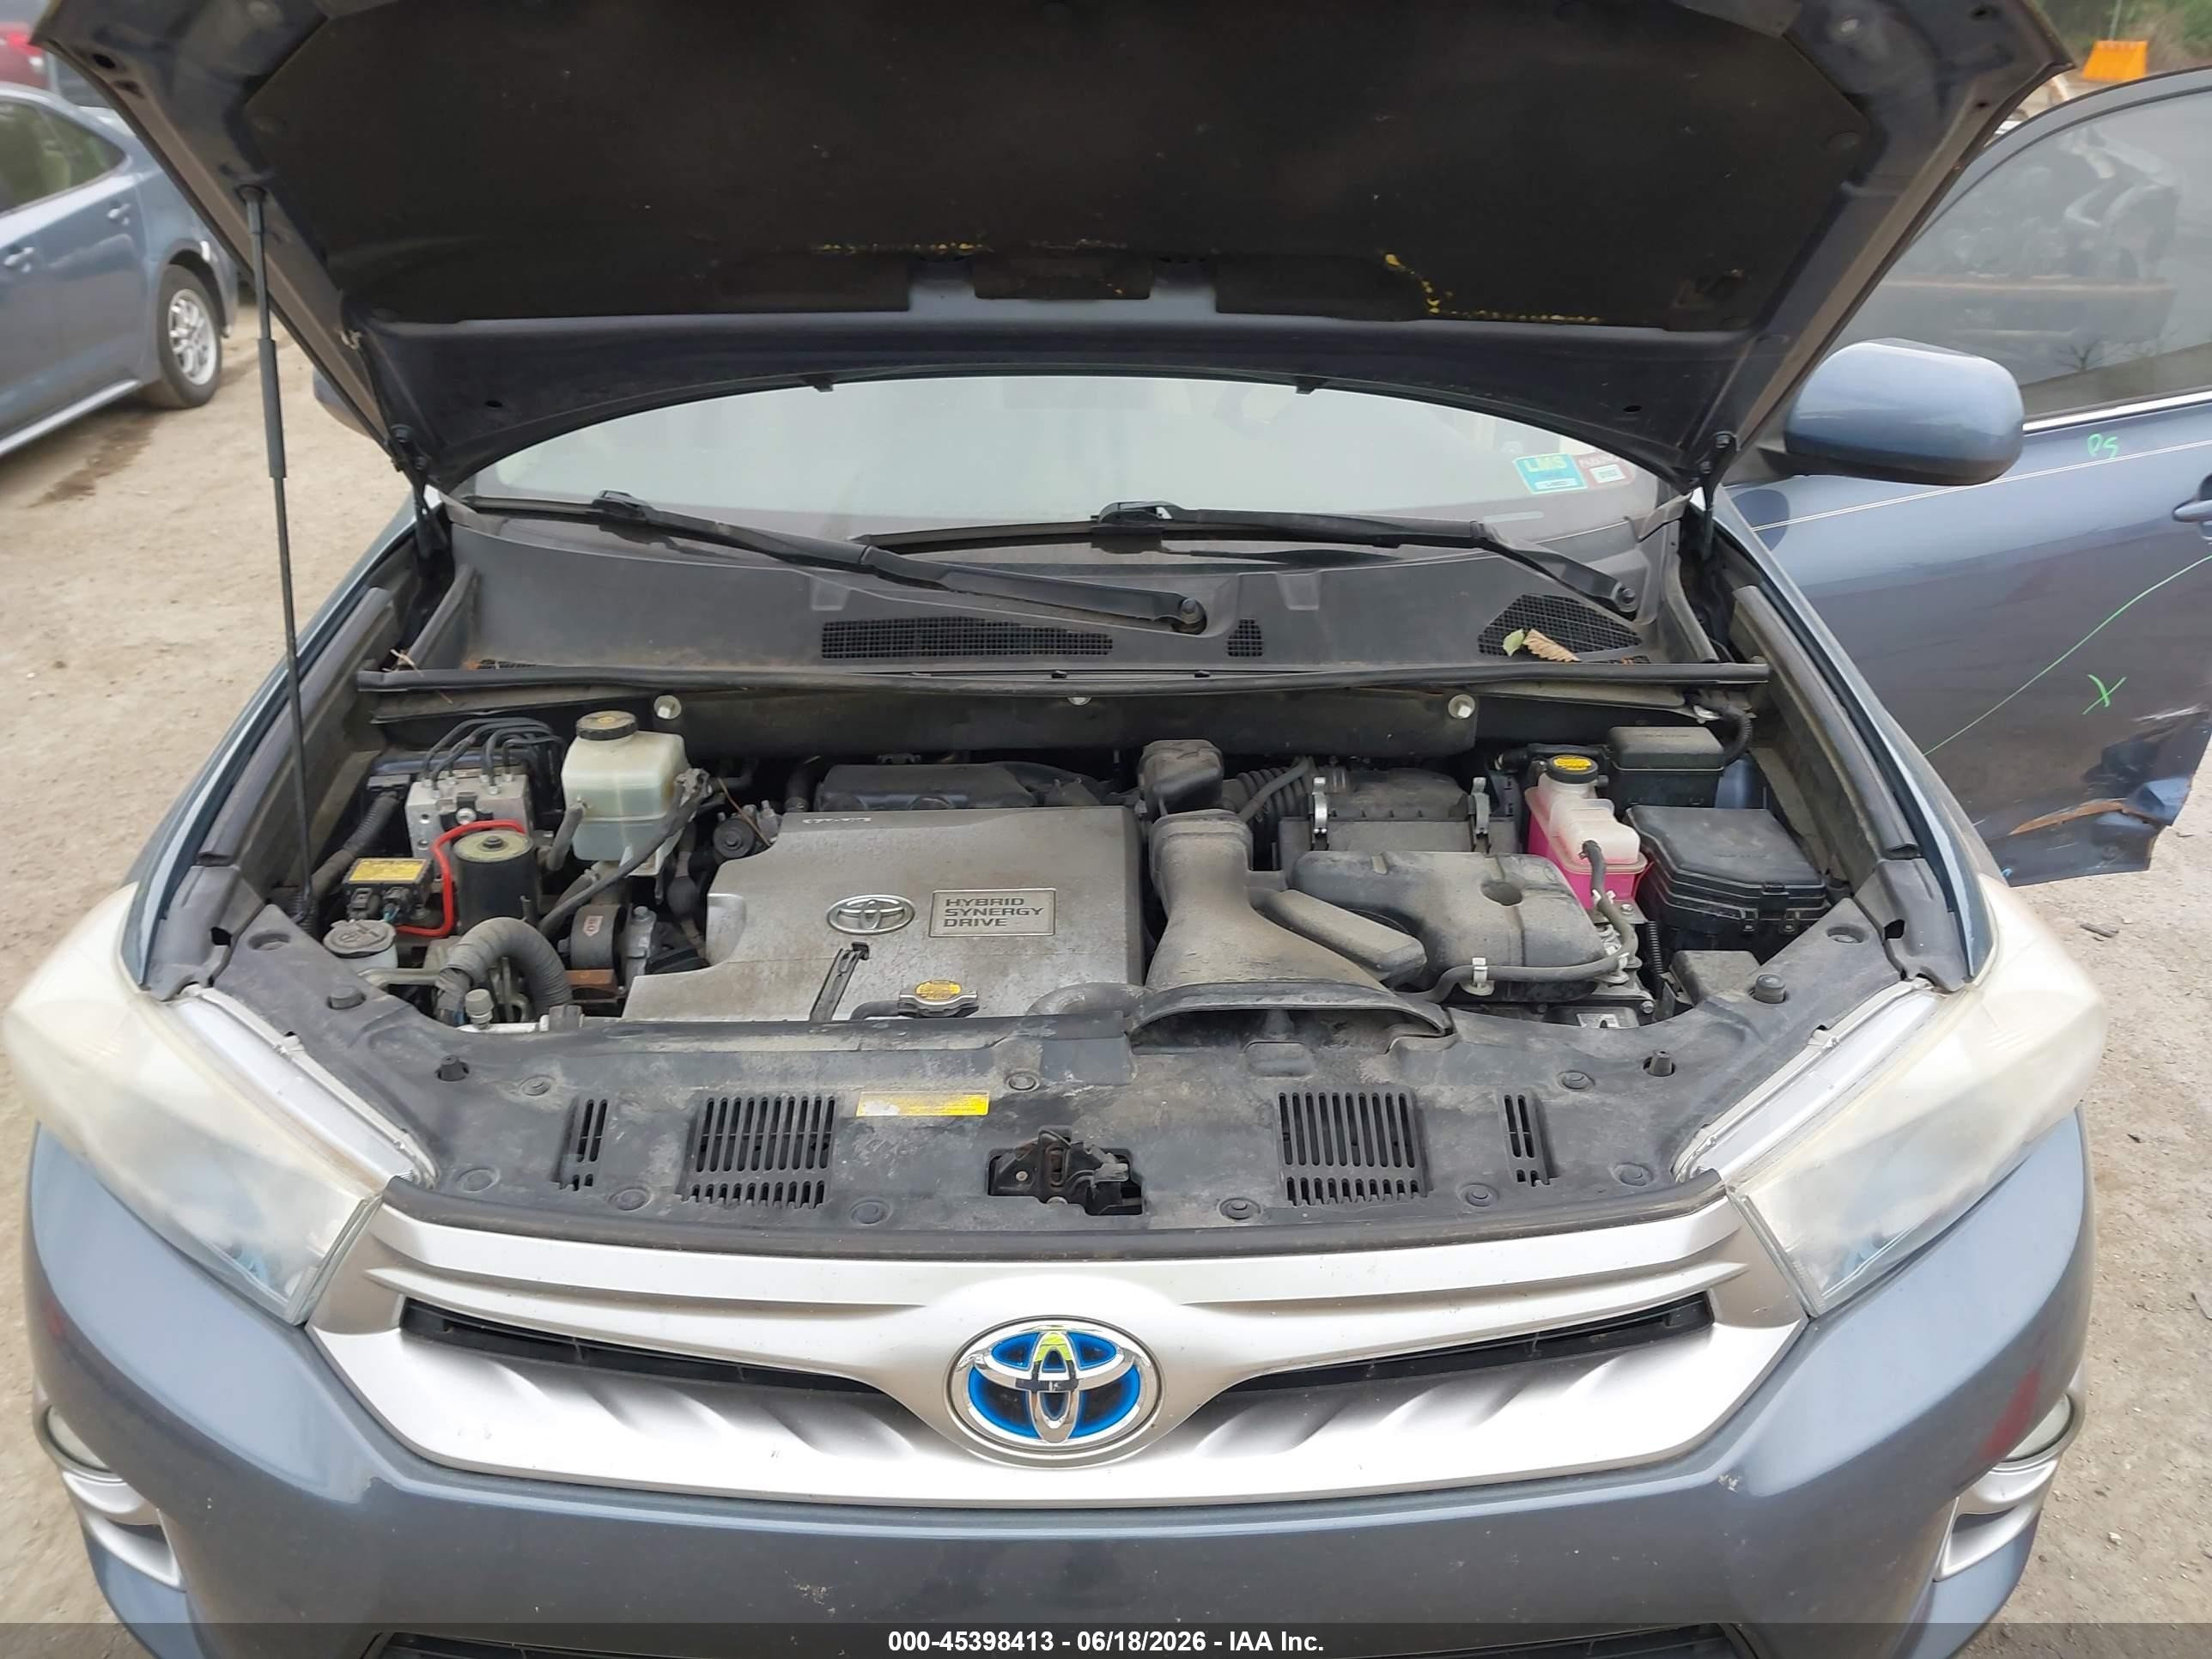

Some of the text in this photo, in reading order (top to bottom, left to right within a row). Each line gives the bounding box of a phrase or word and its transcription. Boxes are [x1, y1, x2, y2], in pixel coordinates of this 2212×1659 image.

[945, 898, 1024, 907] HYBRID
[945, 907, 1045, 917] SYNERGY
[944, 918, 1008, 927] DRIVE
